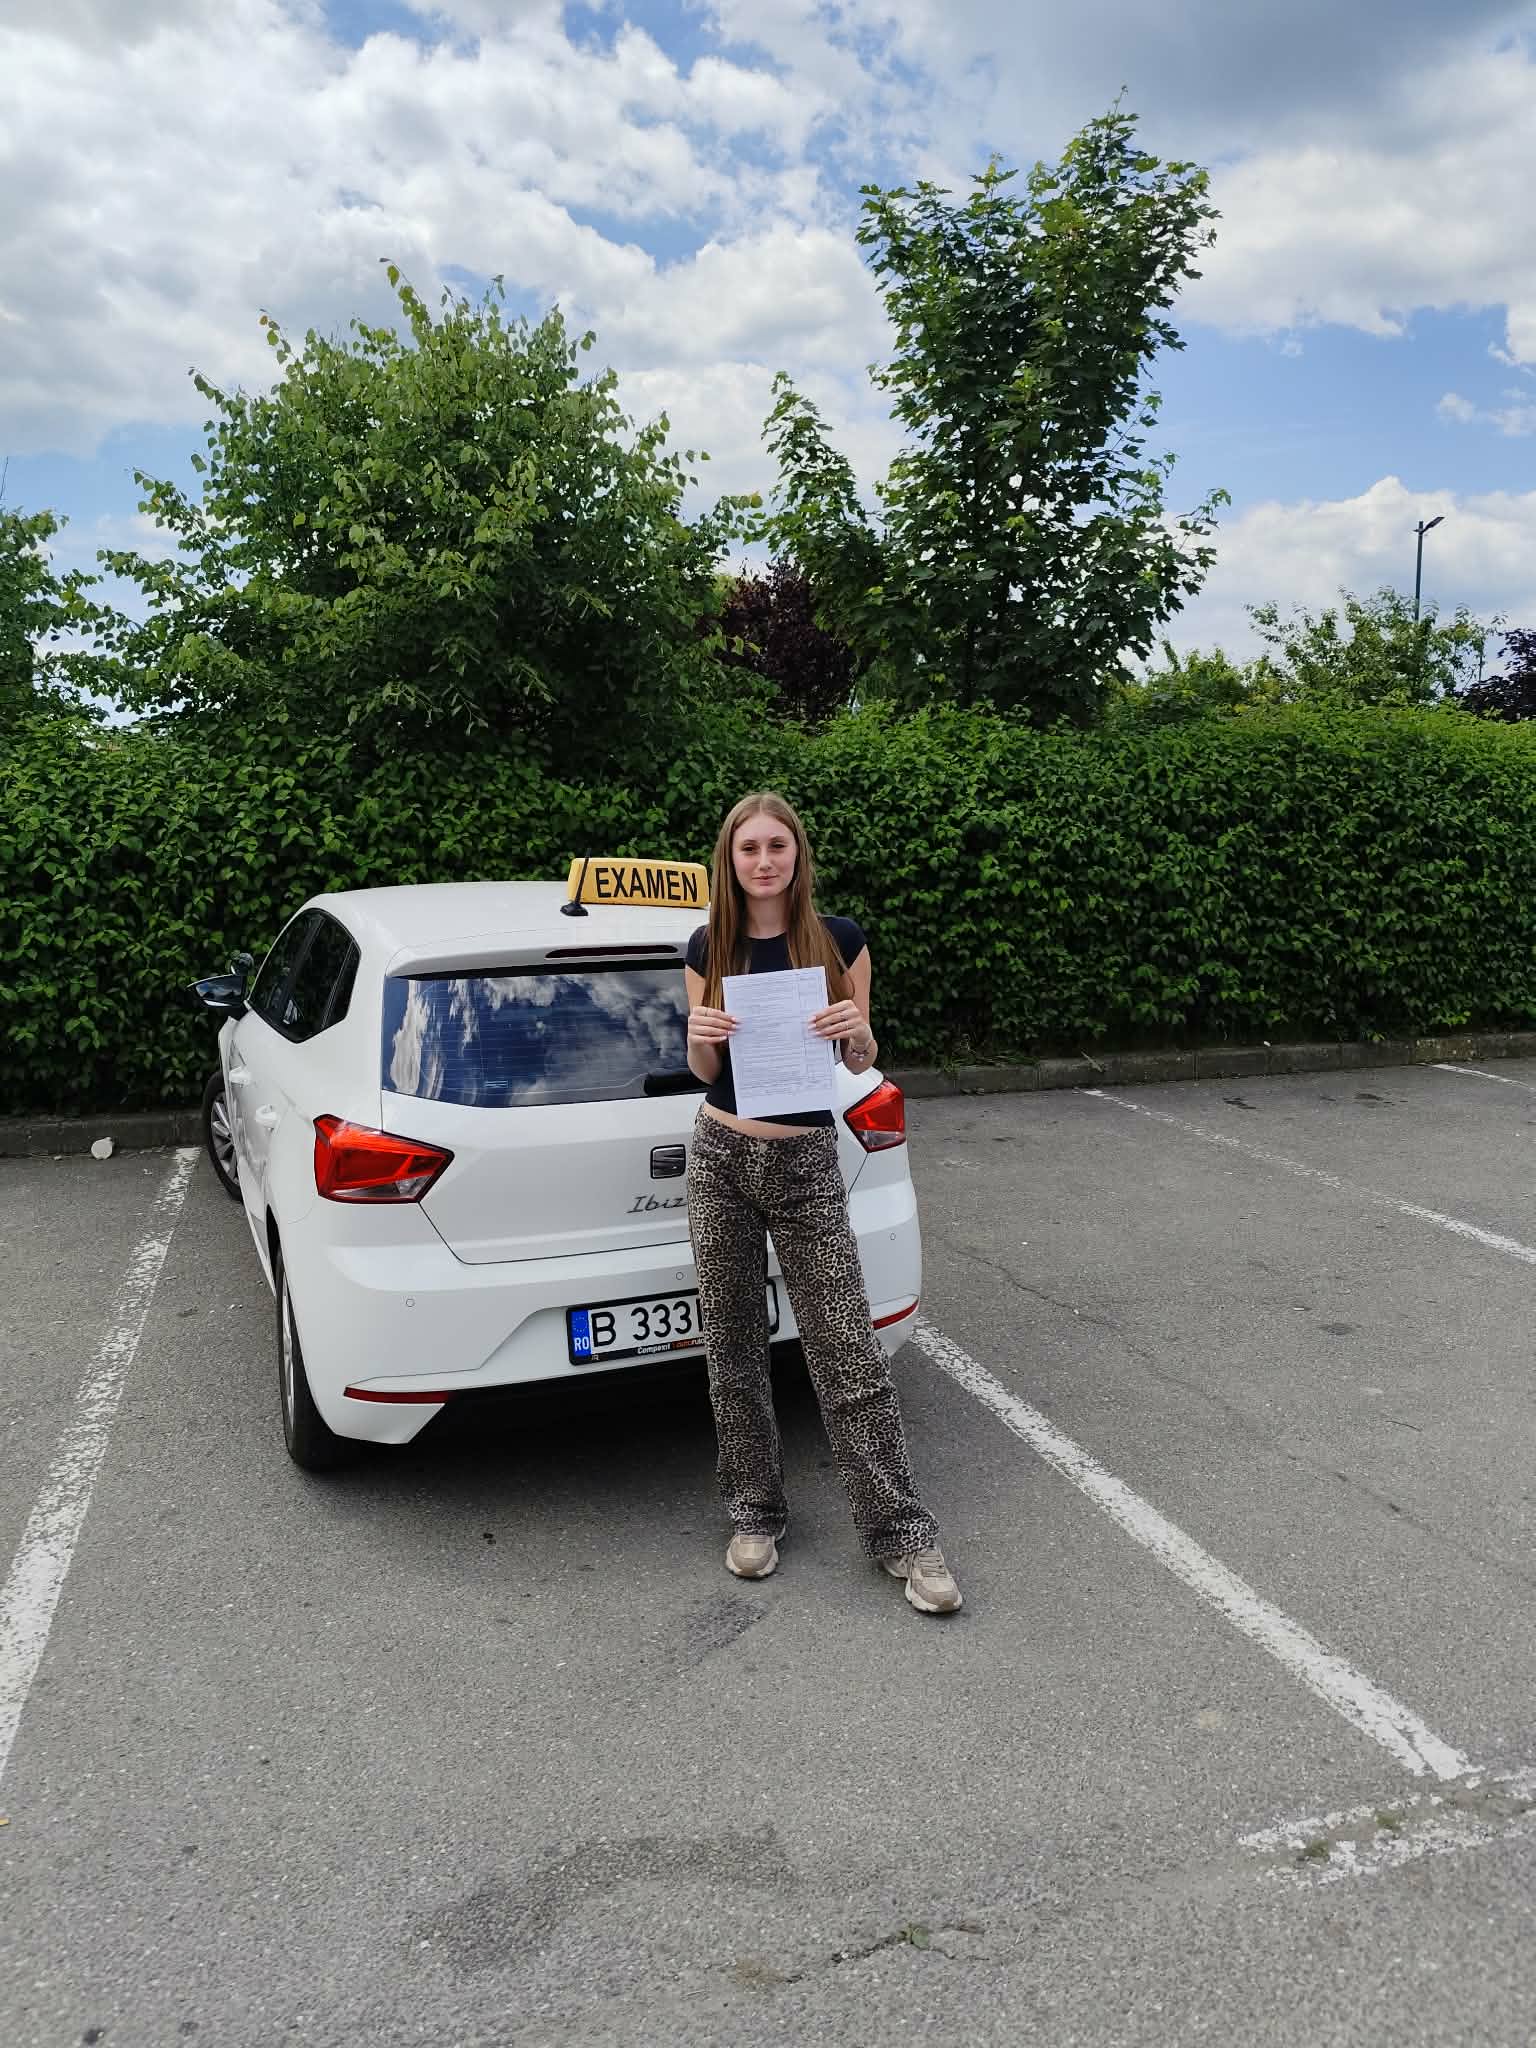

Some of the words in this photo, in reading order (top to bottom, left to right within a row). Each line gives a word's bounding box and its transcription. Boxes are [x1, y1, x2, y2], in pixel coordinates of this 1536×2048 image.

[595, 867, 698, 903] EXAMEN
[626, 1193, 688, 1213] Ibiz
[591, 1311, 617, 1347] B
[630, 1300, 692, 1341] 333
[574, 1336, 590, 1352] RO
